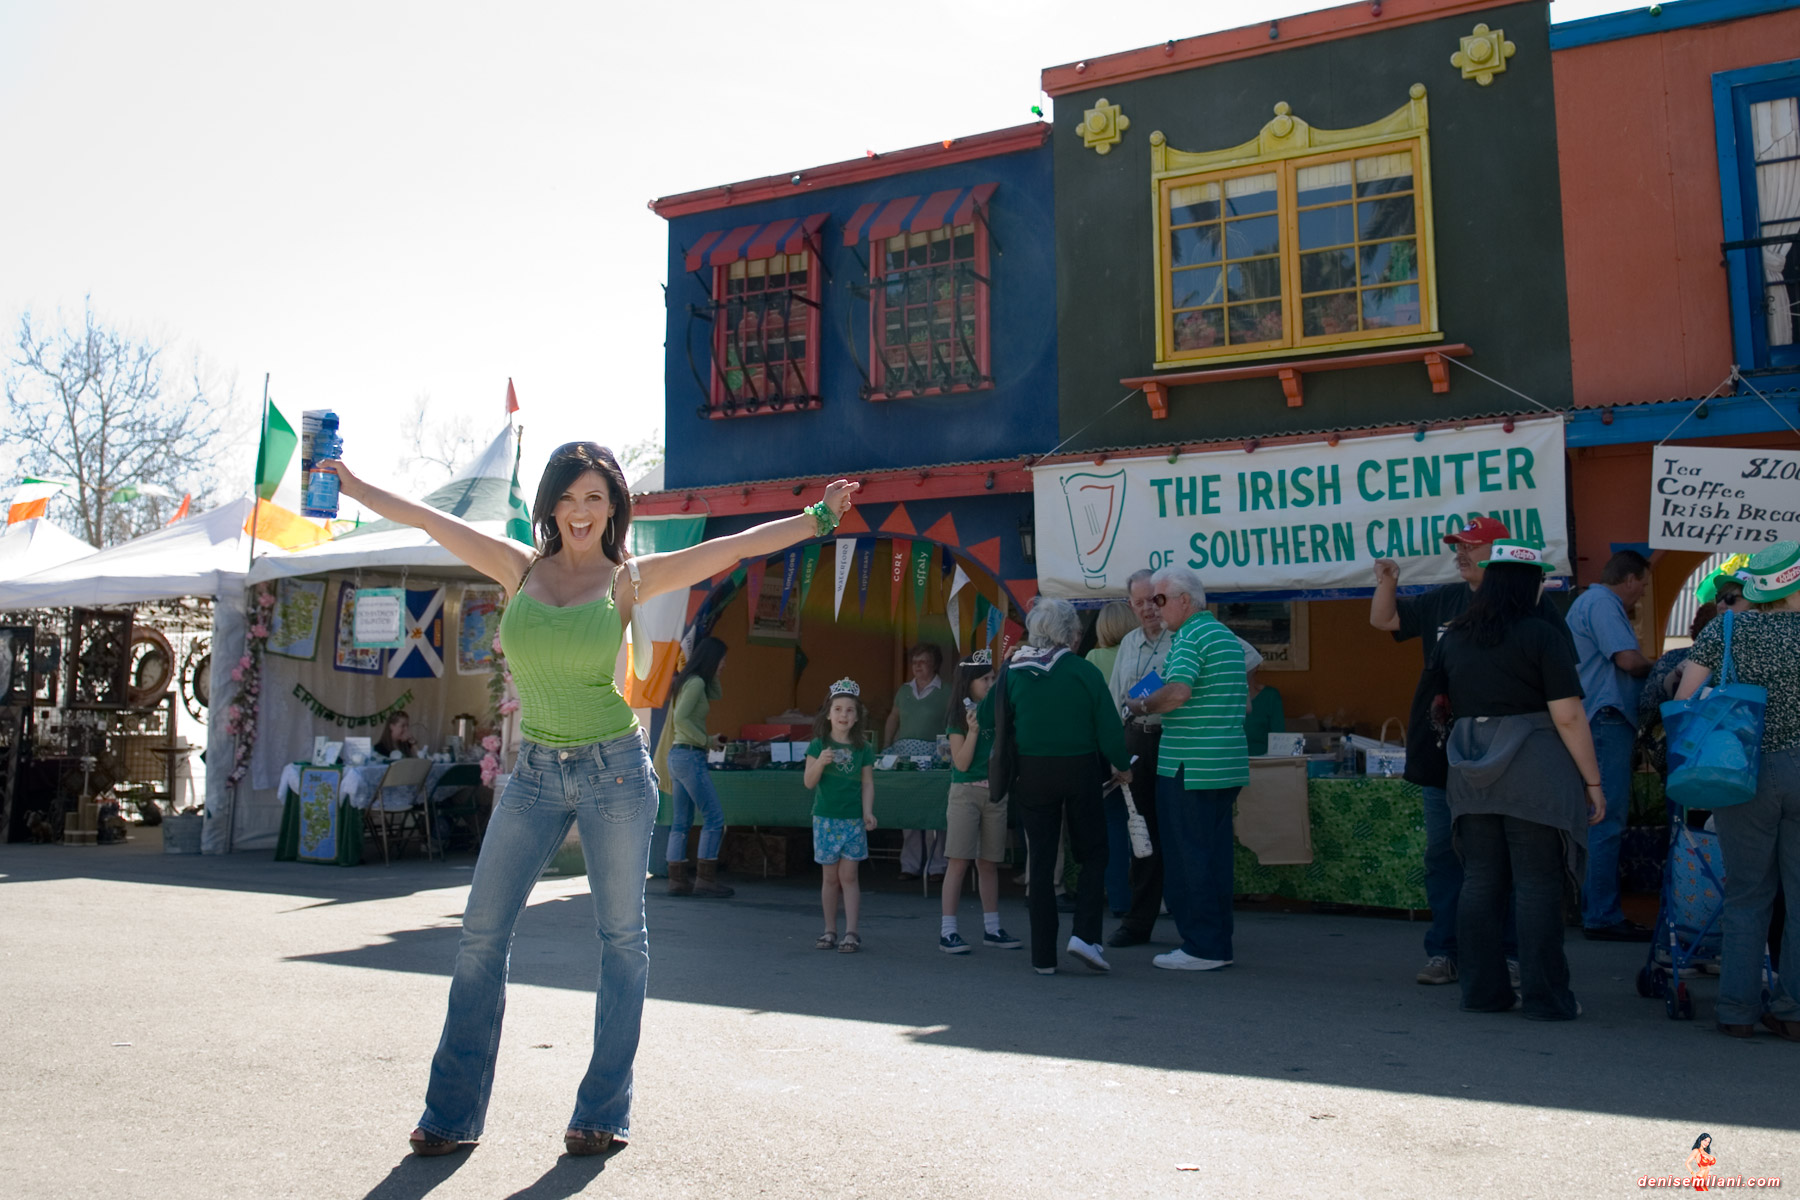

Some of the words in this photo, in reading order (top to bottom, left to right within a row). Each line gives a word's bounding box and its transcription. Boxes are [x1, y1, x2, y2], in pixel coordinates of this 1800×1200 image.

[1664, 458, 1703, 476] Tea
[1150, 474, 1221, 518] THE
[1237, 464, 1342, 512] IRISH
[1357, 447, 1537, 502] CENTER
[1657, 477, 1745, 500] Coffee
[1149, 550, 1174, 571] OF
[1187, 521, 1356, 570] SOUTHERN
[1366, 507, 1546, 559] CALIFONIA
[1660, 520, 1778, 545] Muffins
